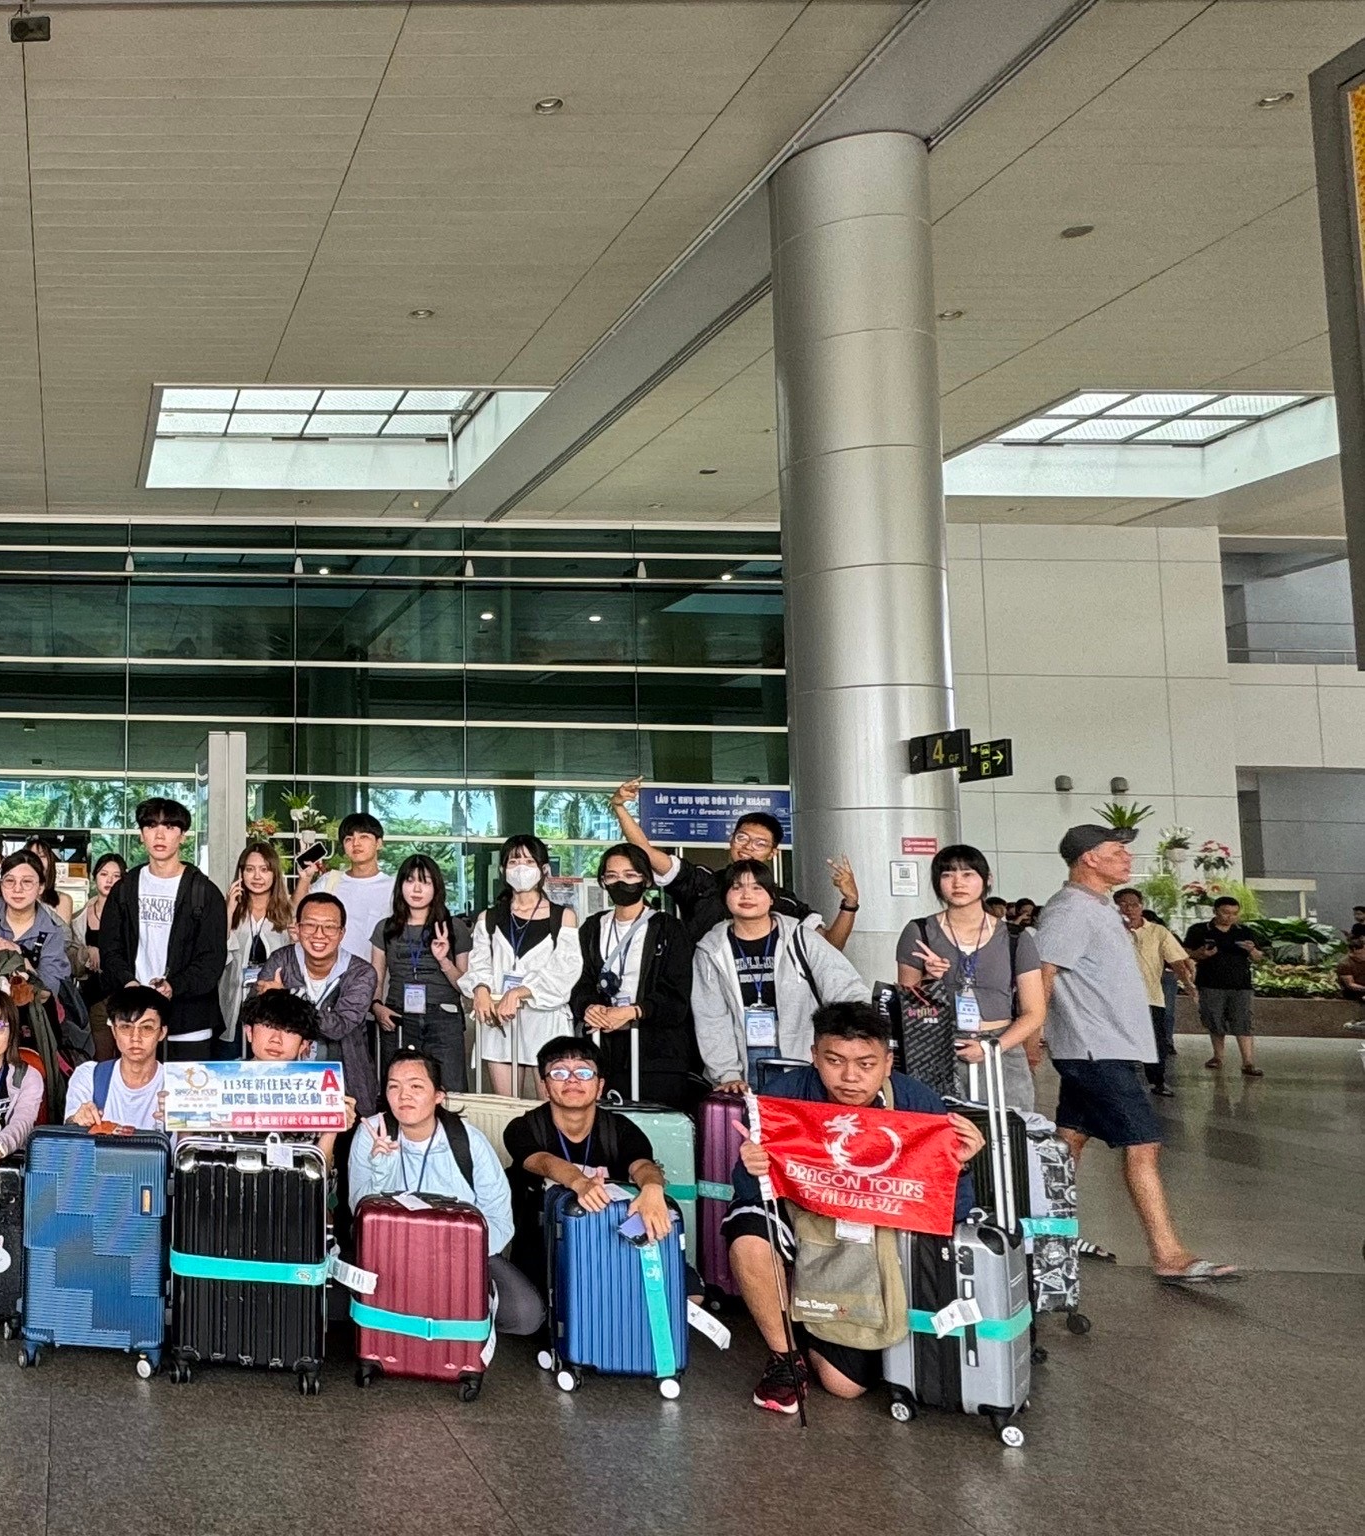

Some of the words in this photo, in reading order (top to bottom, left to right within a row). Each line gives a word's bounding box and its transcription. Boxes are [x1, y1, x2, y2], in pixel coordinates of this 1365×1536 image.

[932, 738, 945, 764] 4
[223, 1078, 318, 1091] 113年新住民子女
[320, 1069, 341, 1092] A
[325, 1093, 339, 1107] 車
[785, 1162, 861, 1190] DRAGON
[868, 1177, 925, 1199] TOURS
